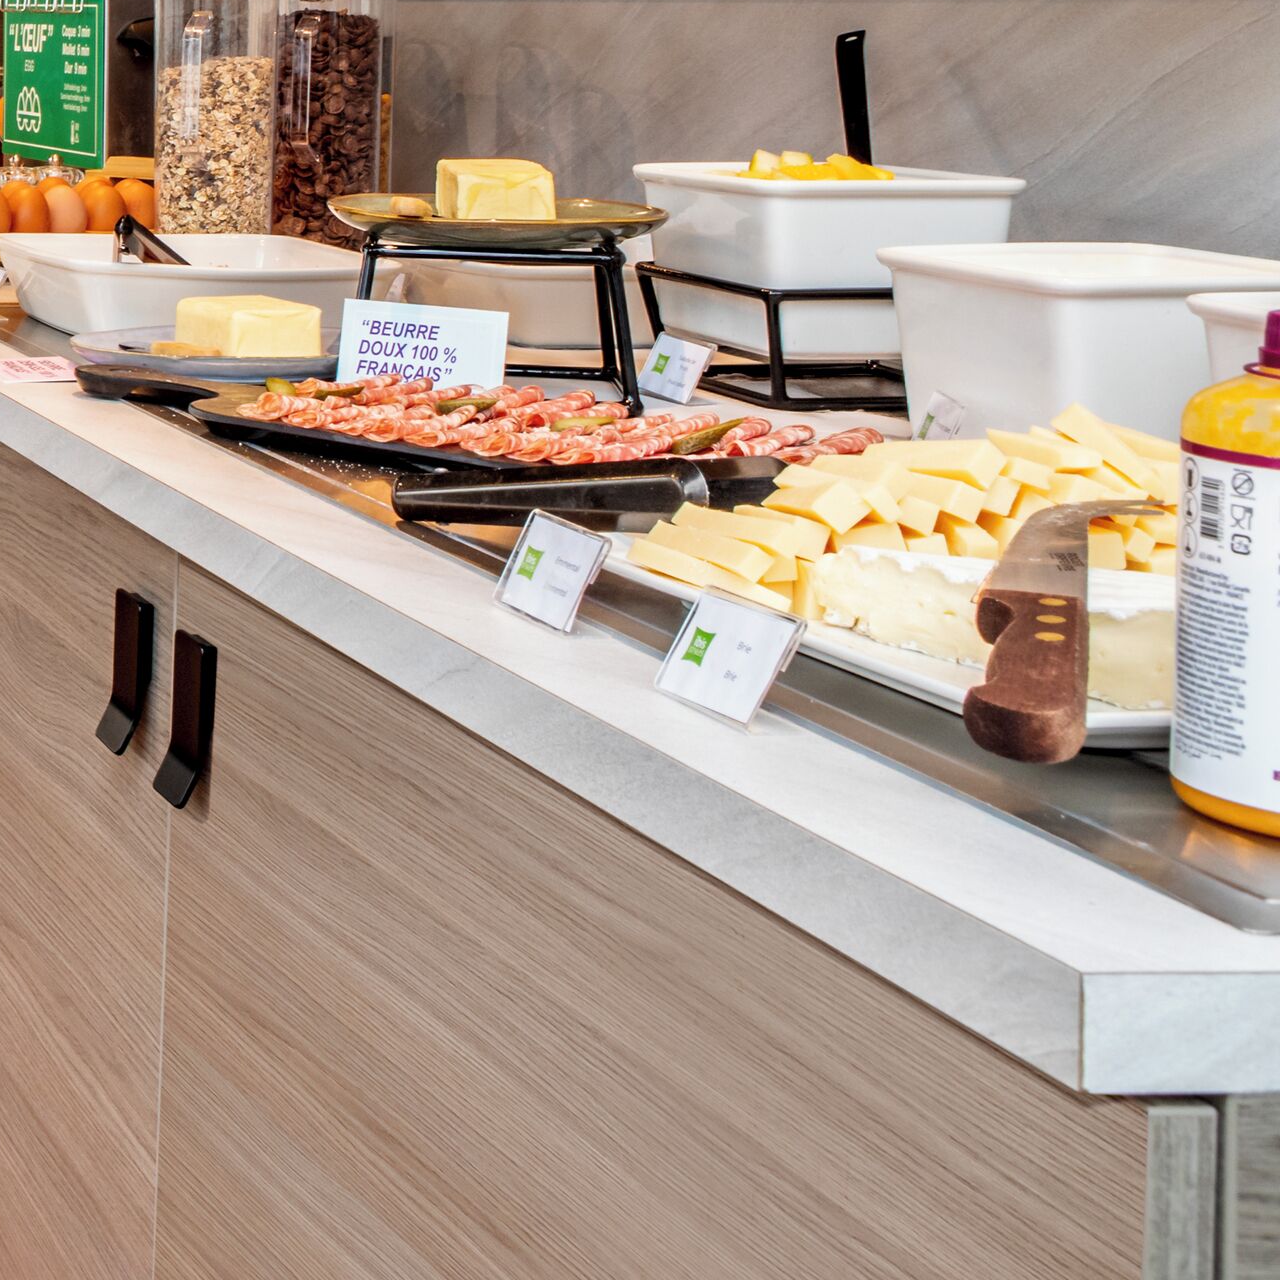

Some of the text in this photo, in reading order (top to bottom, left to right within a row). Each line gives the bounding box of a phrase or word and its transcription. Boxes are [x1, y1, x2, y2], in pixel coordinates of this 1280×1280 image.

[81, 25, 91, 37] min
[81, 44, 90, 56] min
[78, 62, 87, 75] min
[362, 319, 440, 341] “BEURRE
[358, 339, 458, 364] DOUX 100 %
[736, 641, 753, 655] Brie
